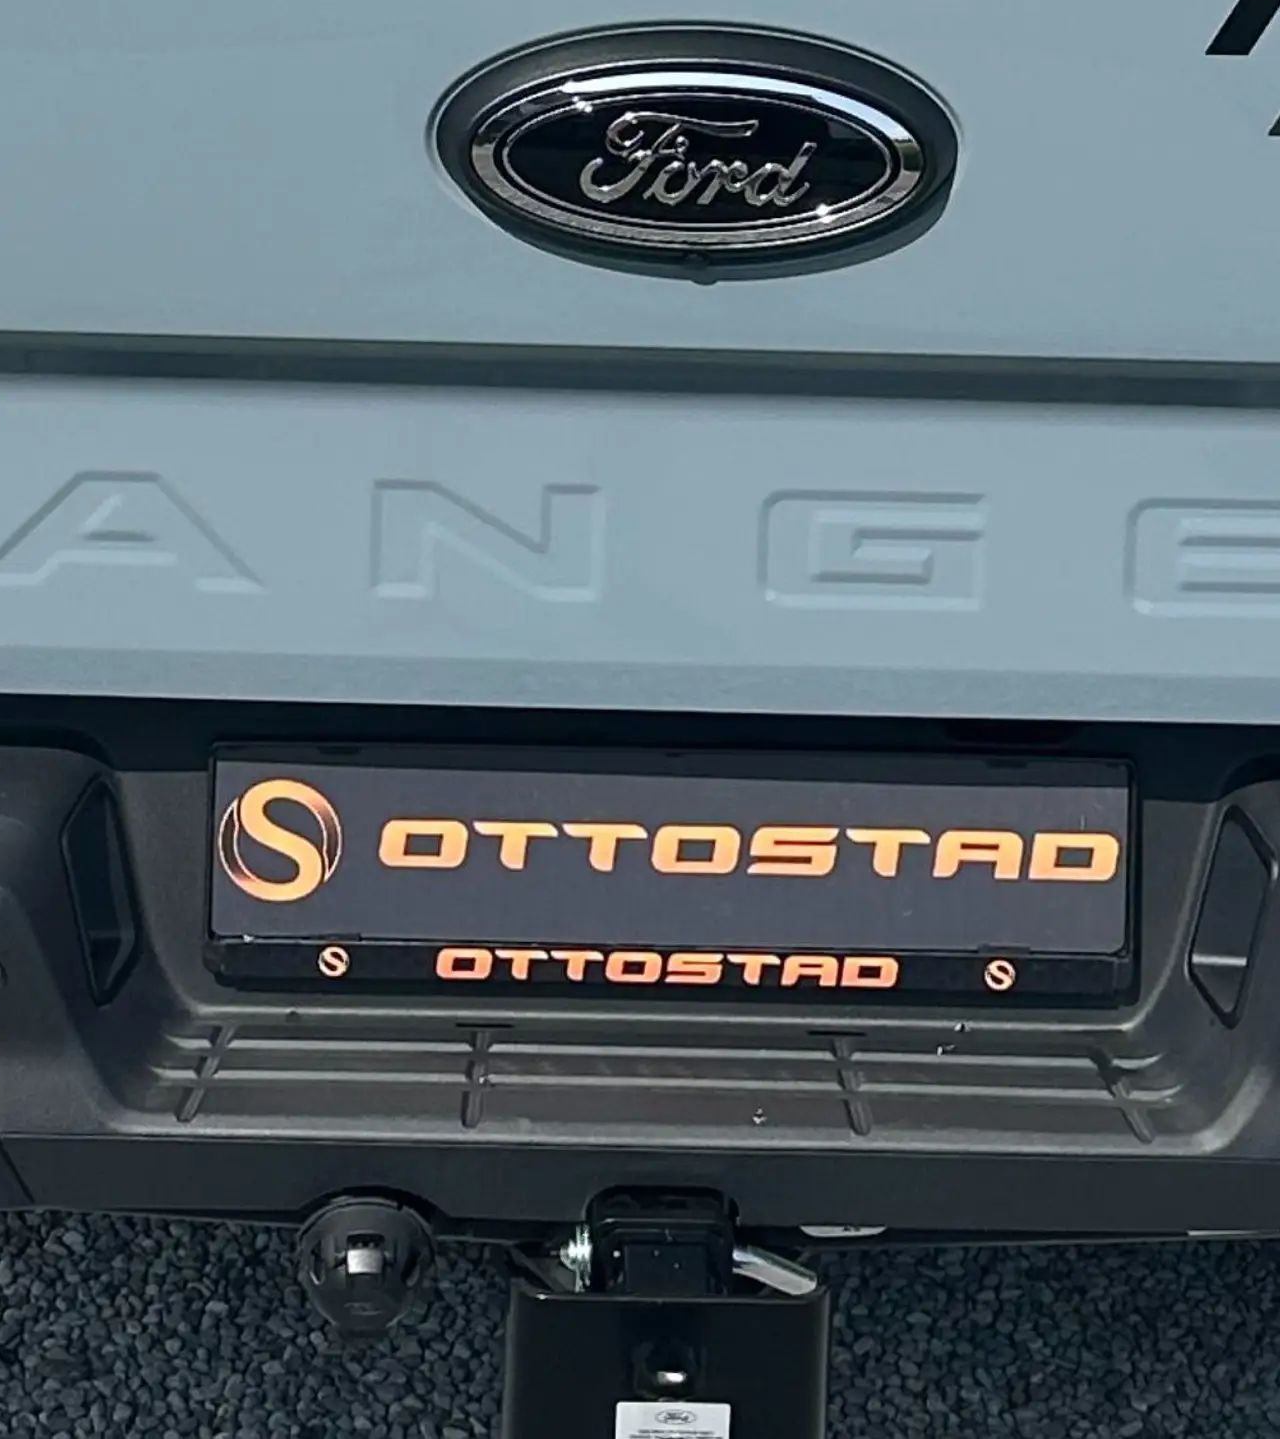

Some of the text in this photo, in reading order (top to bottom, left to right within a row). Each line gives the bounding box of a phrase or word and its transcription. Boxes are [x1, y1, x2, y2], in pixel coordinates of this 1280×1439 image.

[580, 111, 816, 206] Ford
[378, 818, 1121, 882] OTTOSTAD
[435, 948, 900, 988] OTTOSTAD
